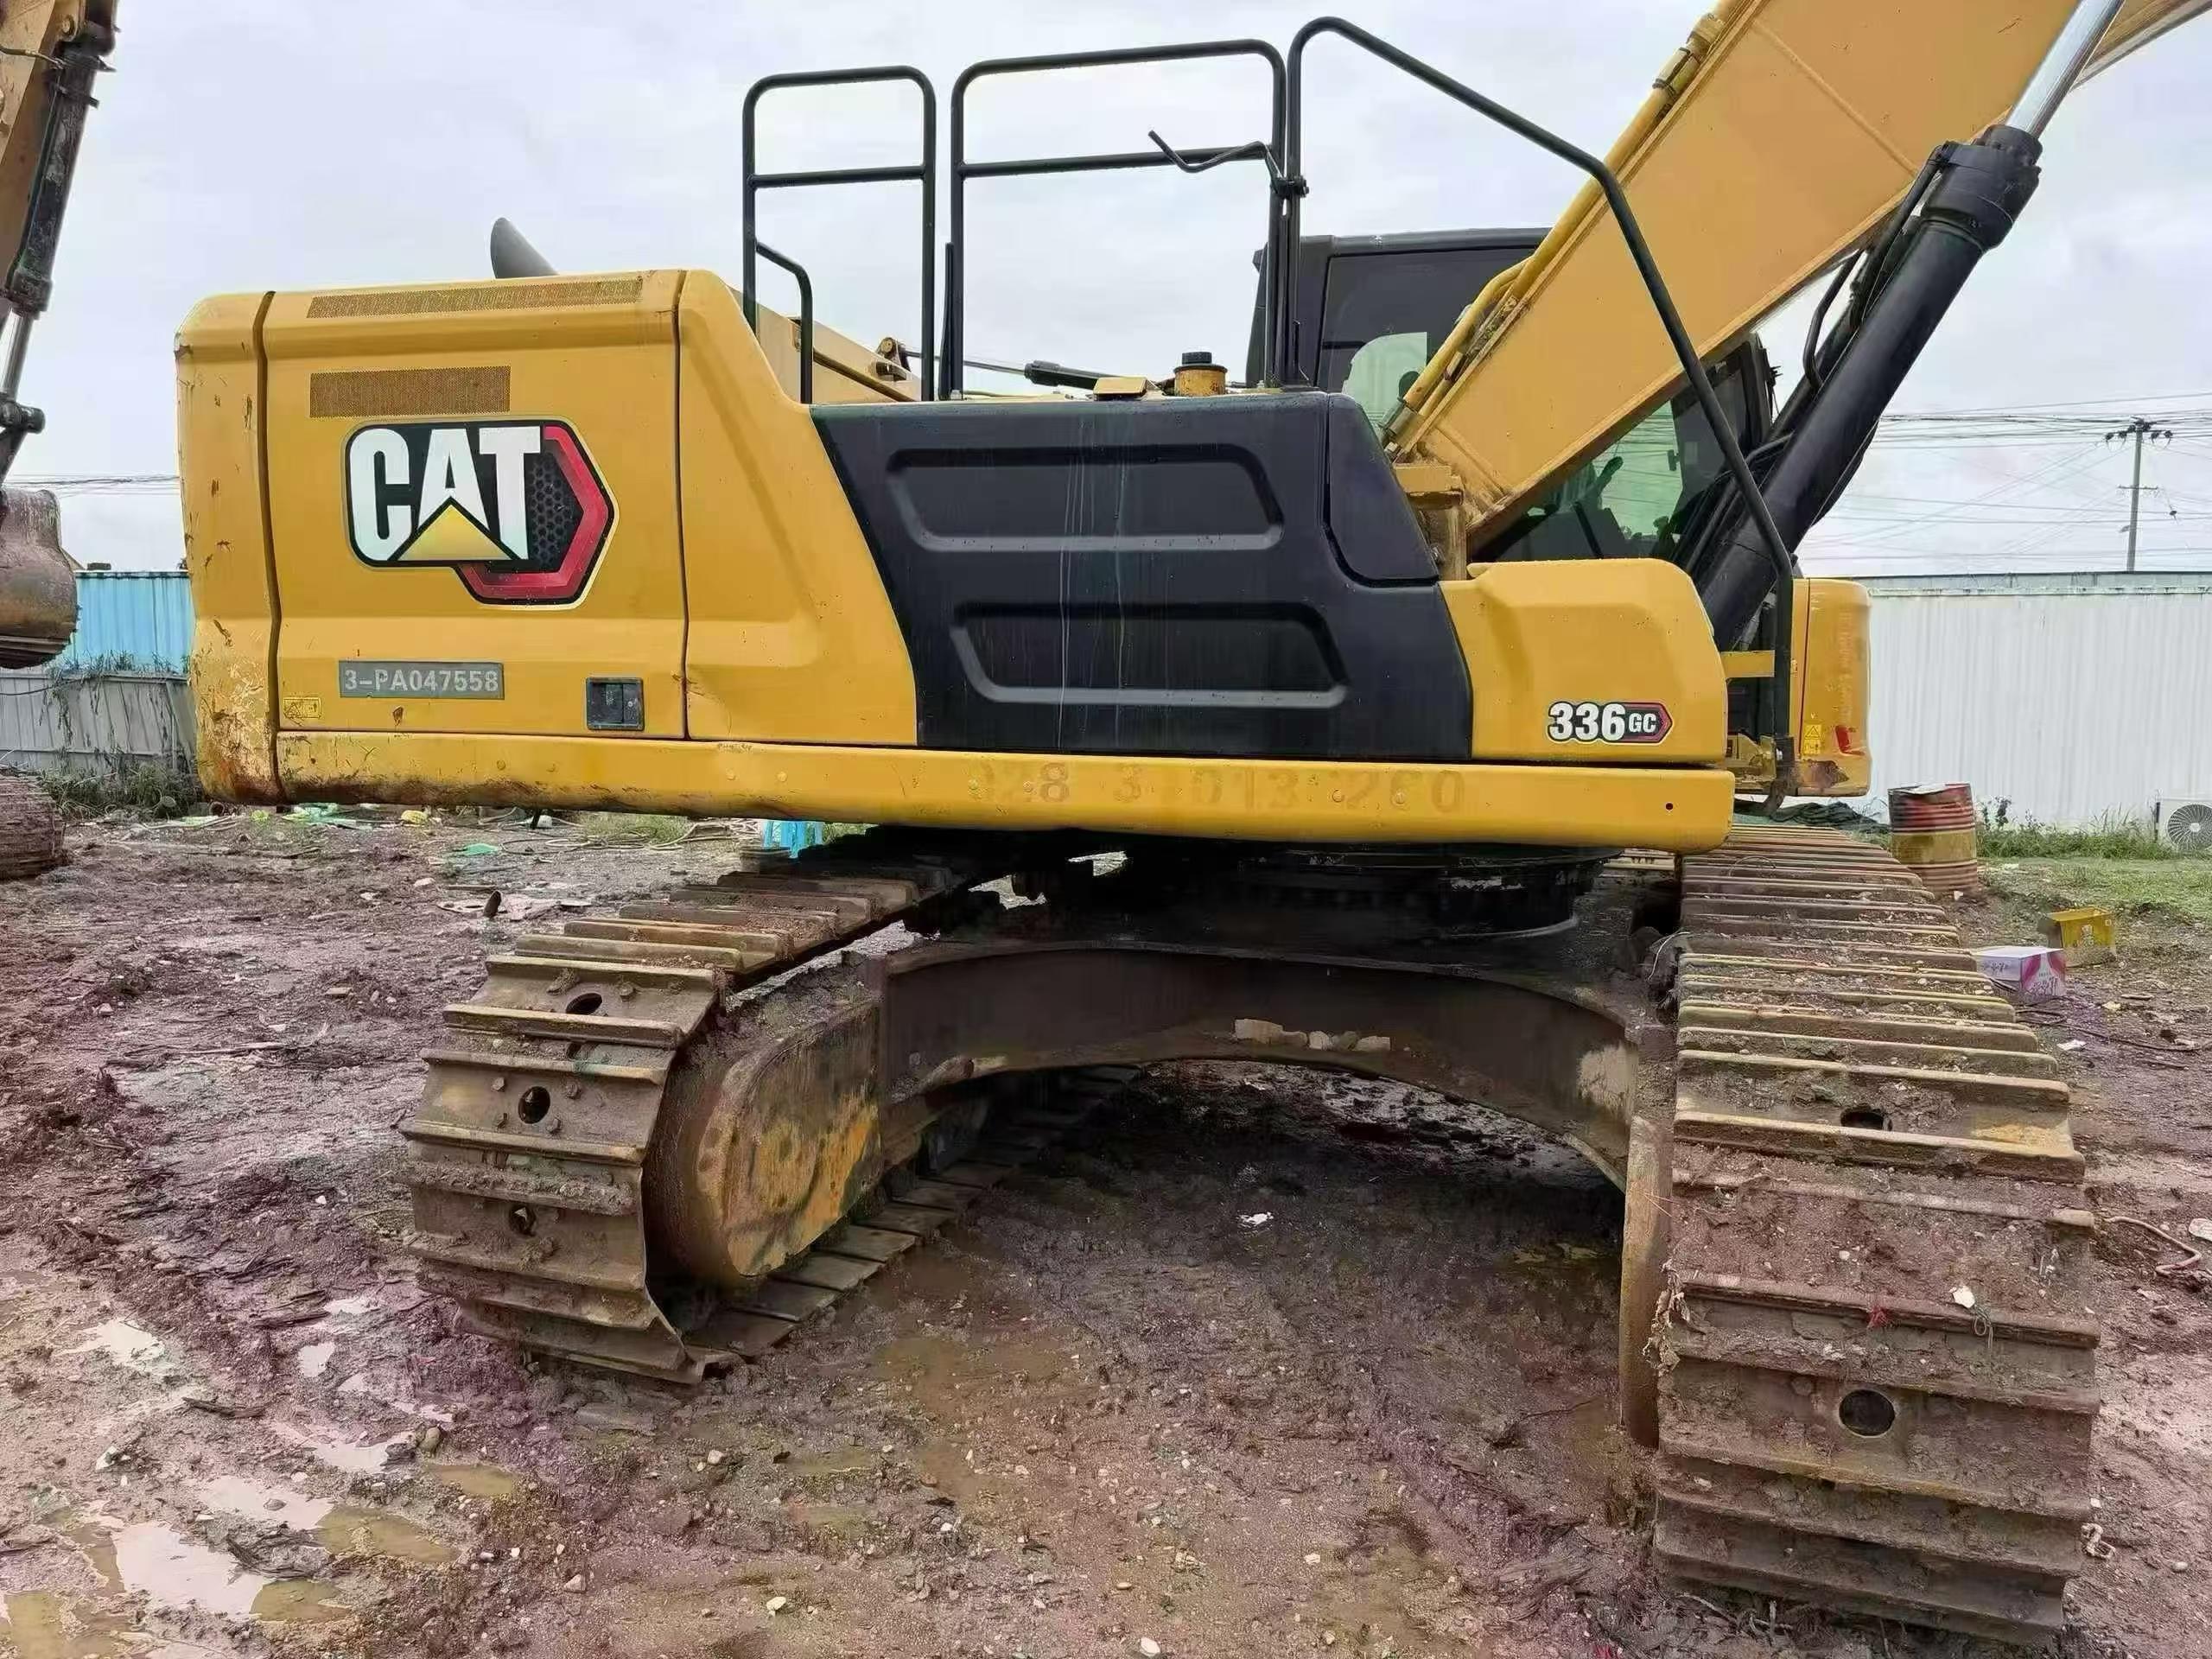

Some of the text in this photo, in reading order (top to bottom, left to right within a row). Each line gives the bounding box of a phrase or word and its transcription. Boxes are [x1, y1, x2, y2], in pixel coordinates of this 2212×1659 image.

[349, 426, 541, 562] CAT
[345, 669, 499, 692] 3-PA047558
[1549, 702, 1656, 741] 336 GC
